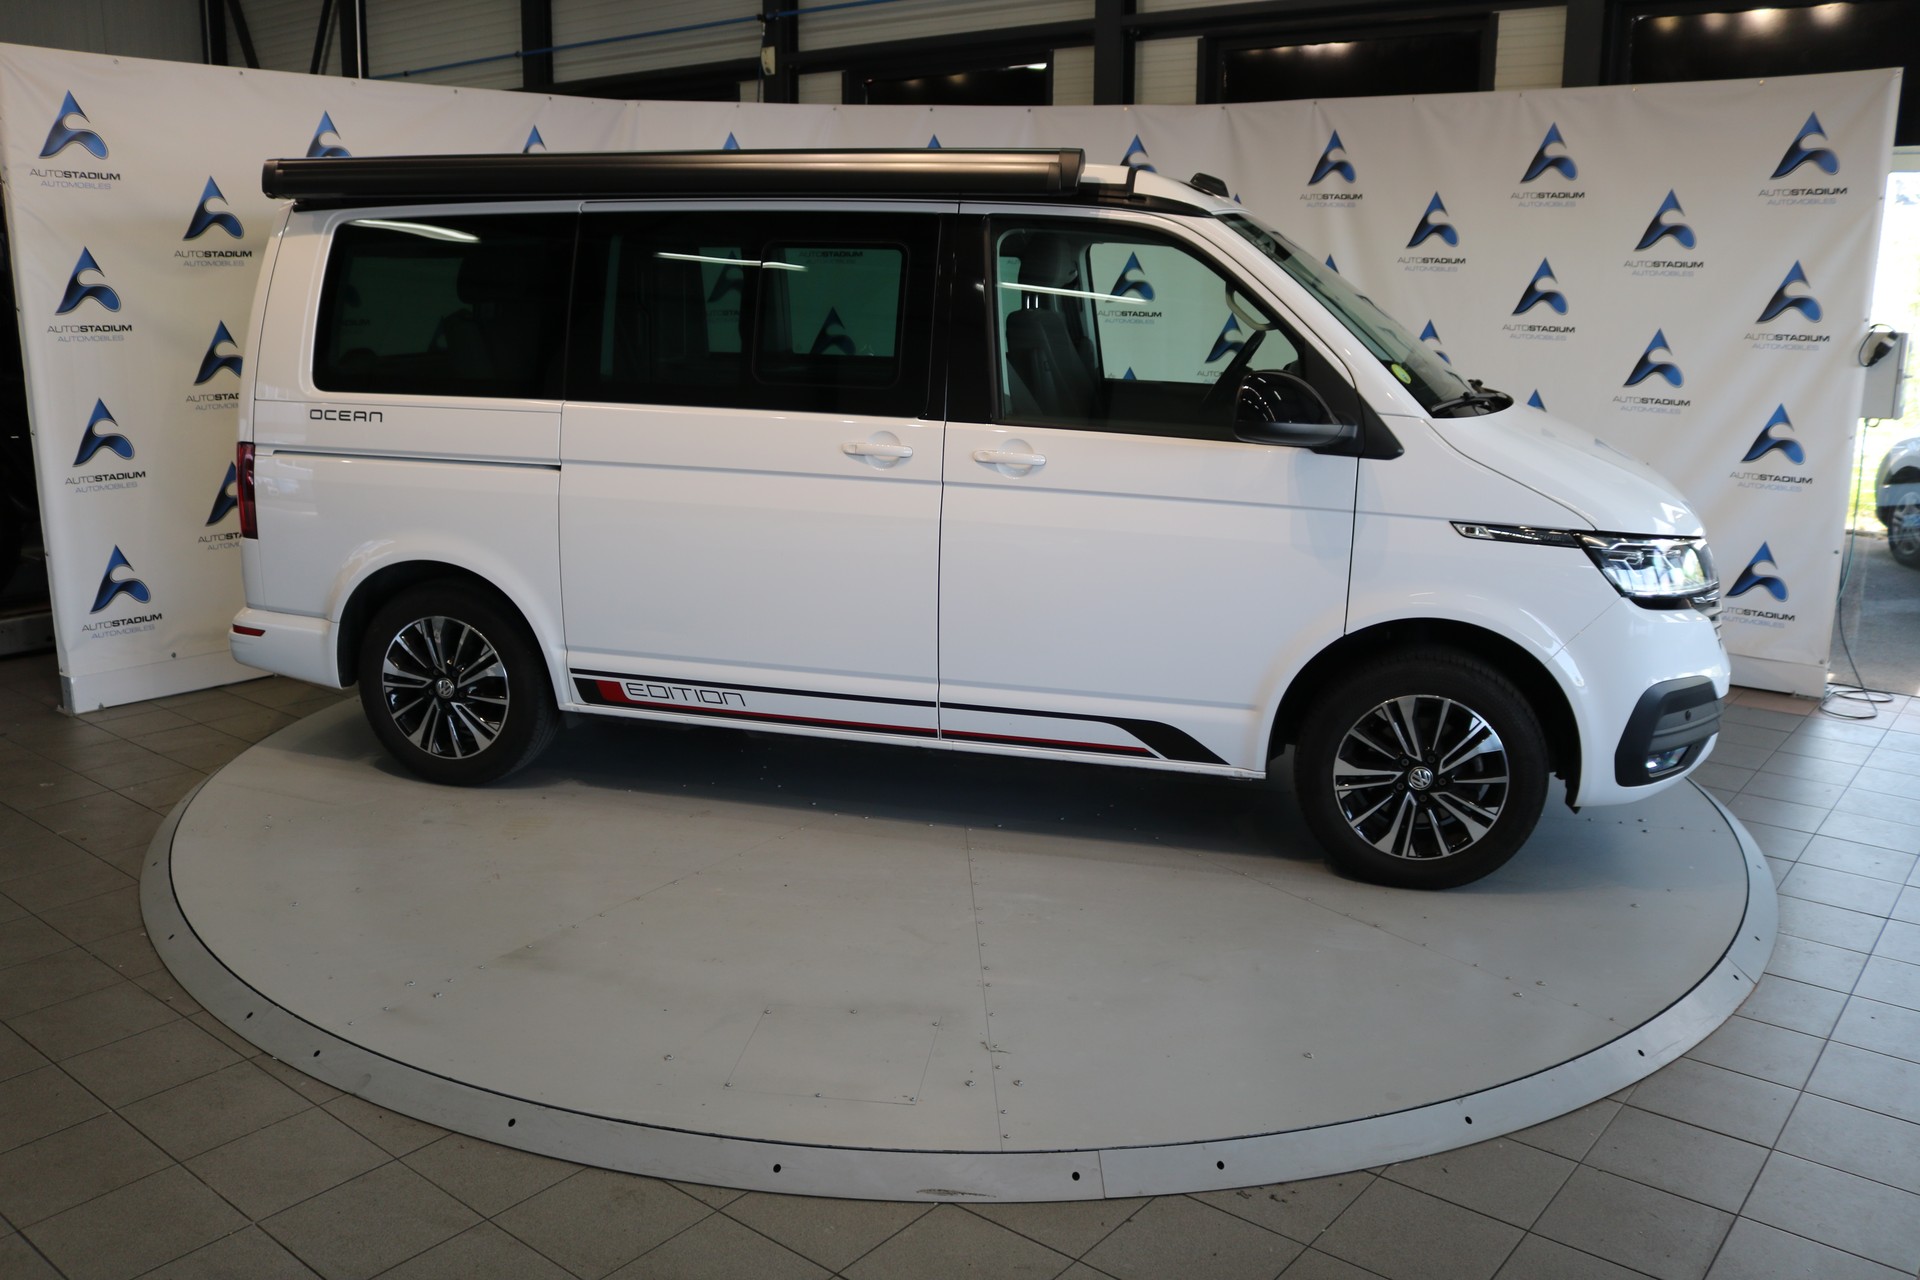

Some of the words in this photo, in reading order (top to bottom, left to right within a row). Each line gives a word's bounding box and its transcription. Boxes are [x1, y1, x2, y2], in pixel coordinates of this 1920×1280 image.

[29, 168, 121, 181] AUTOSTADIUM
[40, 180, 111, 190] AUTOMOBILES
[1511, 191, 1585, 199] AUTOSTADIUM
[1758, 187, 1848, 197] AUTOSTADIUM
[174, 250, 252, 258] AUTOSTADIUM
[1397, 256, 1466, 265] AUTOSTADIUM
[1624, 260, 1704, 268] AUTOSTADIUM
[47, 324, 133, 334] AUTOSTADIUM
[1502, 324, 1576, 333] AUTOSTADIUM
[1744, 333, 1830, 342] AUTOSTADIUM
[1612, 395, 1691, 407] AUTOSTADIUM
[309, 409, 383, 423] OCEAN
[65, 471, 146, 485] AUTOSTADIUM
[1729, 471, 1813, 485] AUTOSTADIUM
[1721, 606, 1796, 622] UTOSTADIUM
[81, 613, 163, 632] AUTOSTADIUM
[626, 682, 746, 707] EDITION
